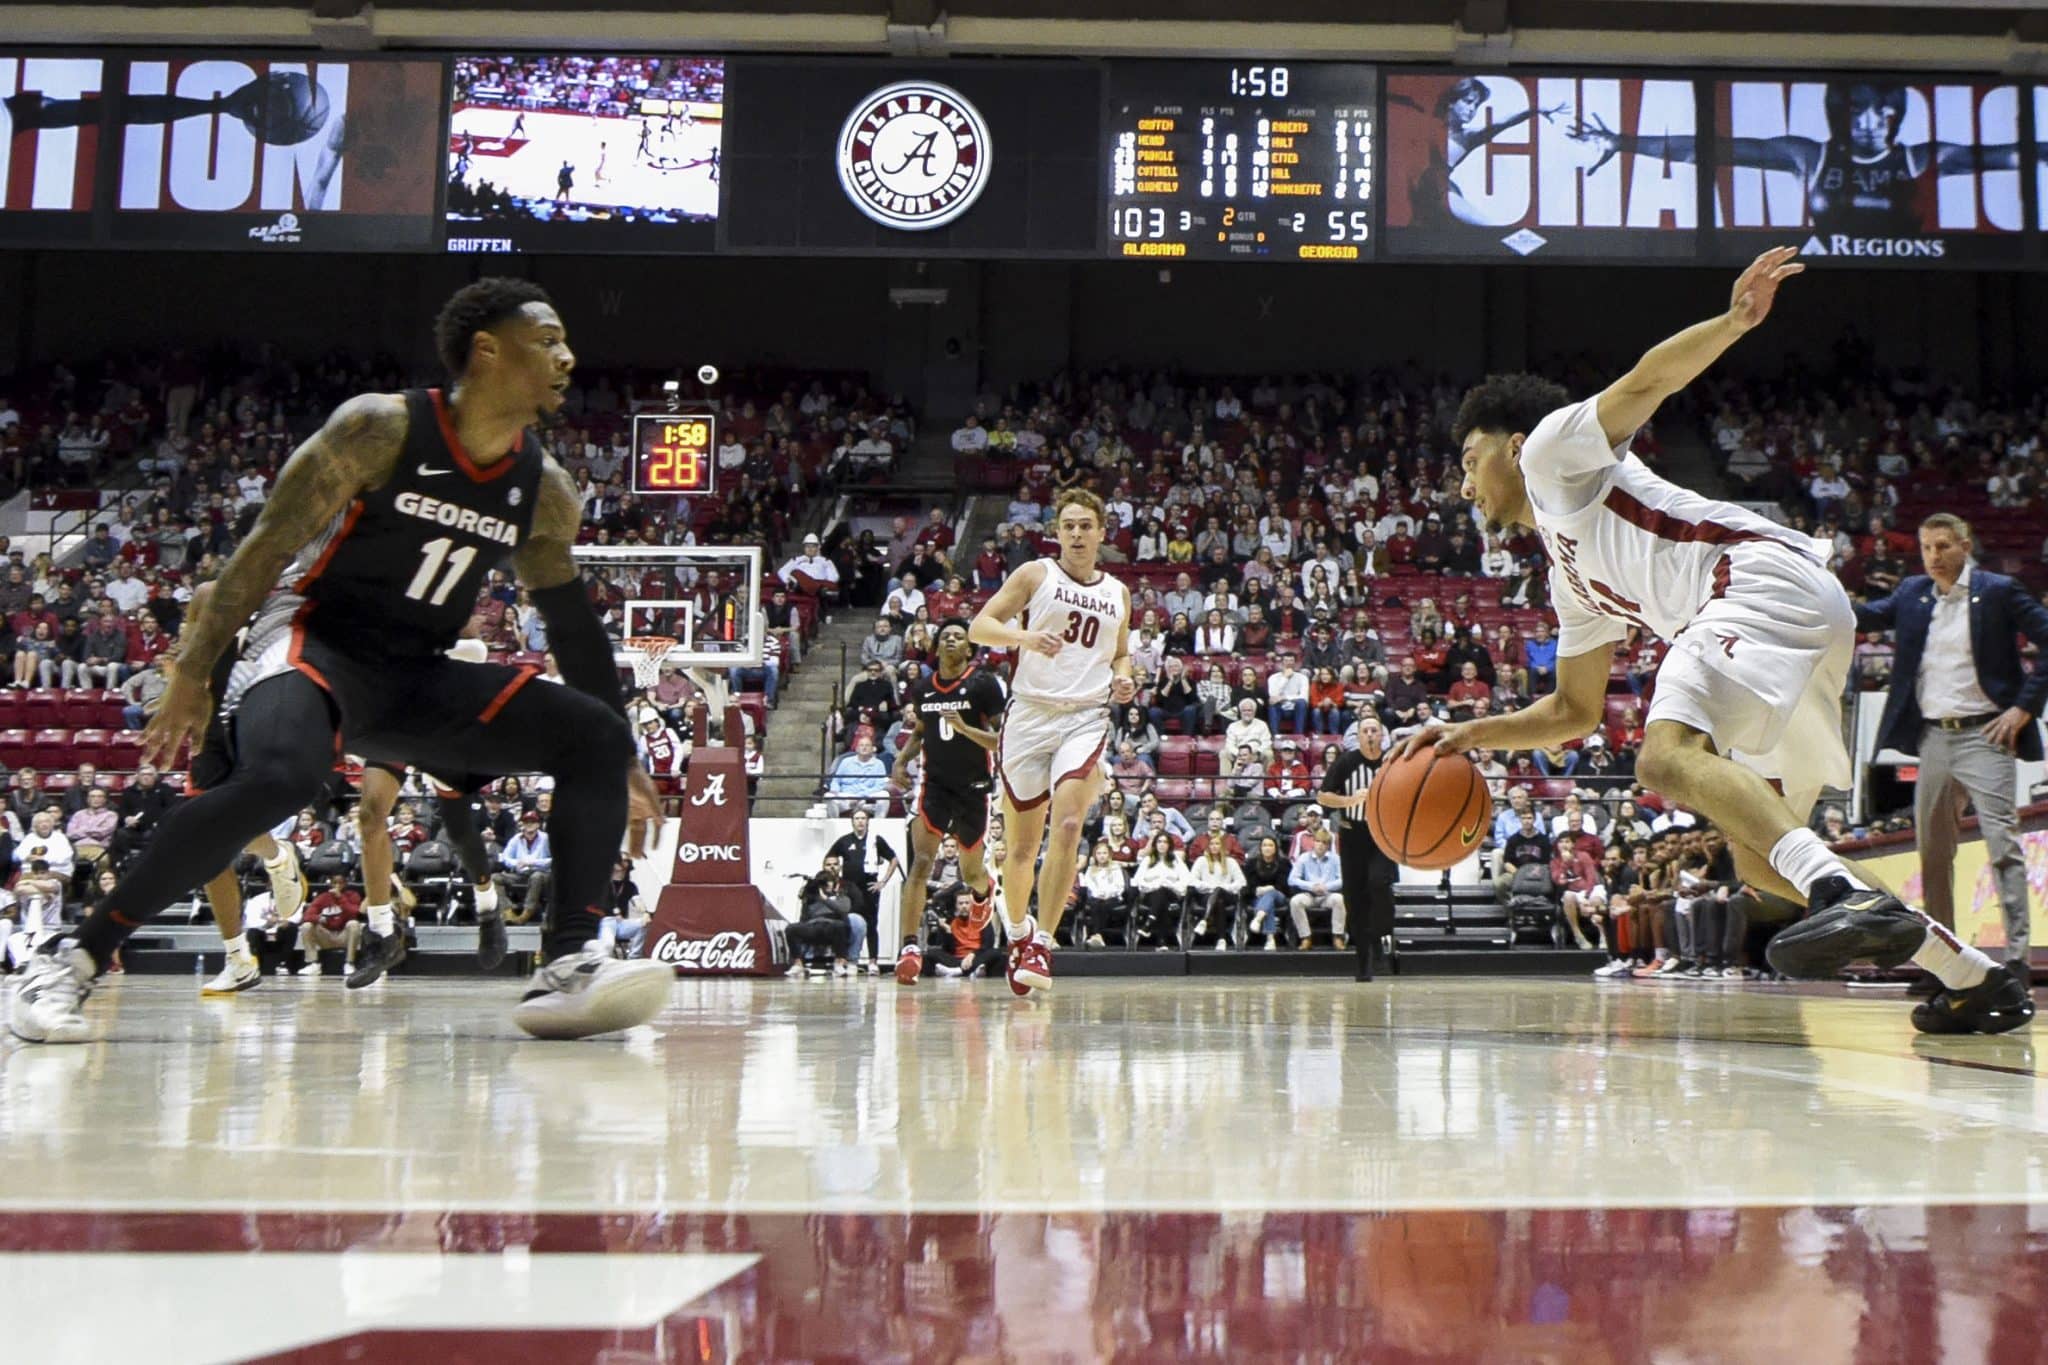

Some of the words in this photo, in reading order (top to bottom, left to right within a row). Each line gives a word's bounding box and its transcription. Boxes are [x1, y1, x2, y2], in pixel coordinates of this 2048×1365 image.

[1231, 67, 1289, 97] 1:58
[856, 96, 974, 149] ALABAMA
[881, 131, 939, 177] A
[1113, 208, 1165, 238] 103
[1179, 211, 1191, 231] 3
[1222, 207, 1235, 226] 2
[1292, 212, 1306, 233] 2
[1328, 211, 1368, 241] 55
[447, 238, 512, 252] GRIFFEN
[1123, 242, 1186, 256] ALABAMA
[1299, 244, 1359, 259] GEORGIA
[1830, 234, 1945, 257] REGIONS
[664, 423, 707, 446] 1:58
[649, 448, 697, 485] 28
[394, 492, 519, 547] GEORGIA
[405, 537, 479, 606] 11
[1054, 587, 1117, 618] ALABAMA
[1064, 611, 1100, 649] 30
[921, 700, 971, 713] GEORGIA
[691, 773, 728, 806] A
[700, 845, 741, 861] PNC
[651, 931, 755, 969] Coca-Cola
